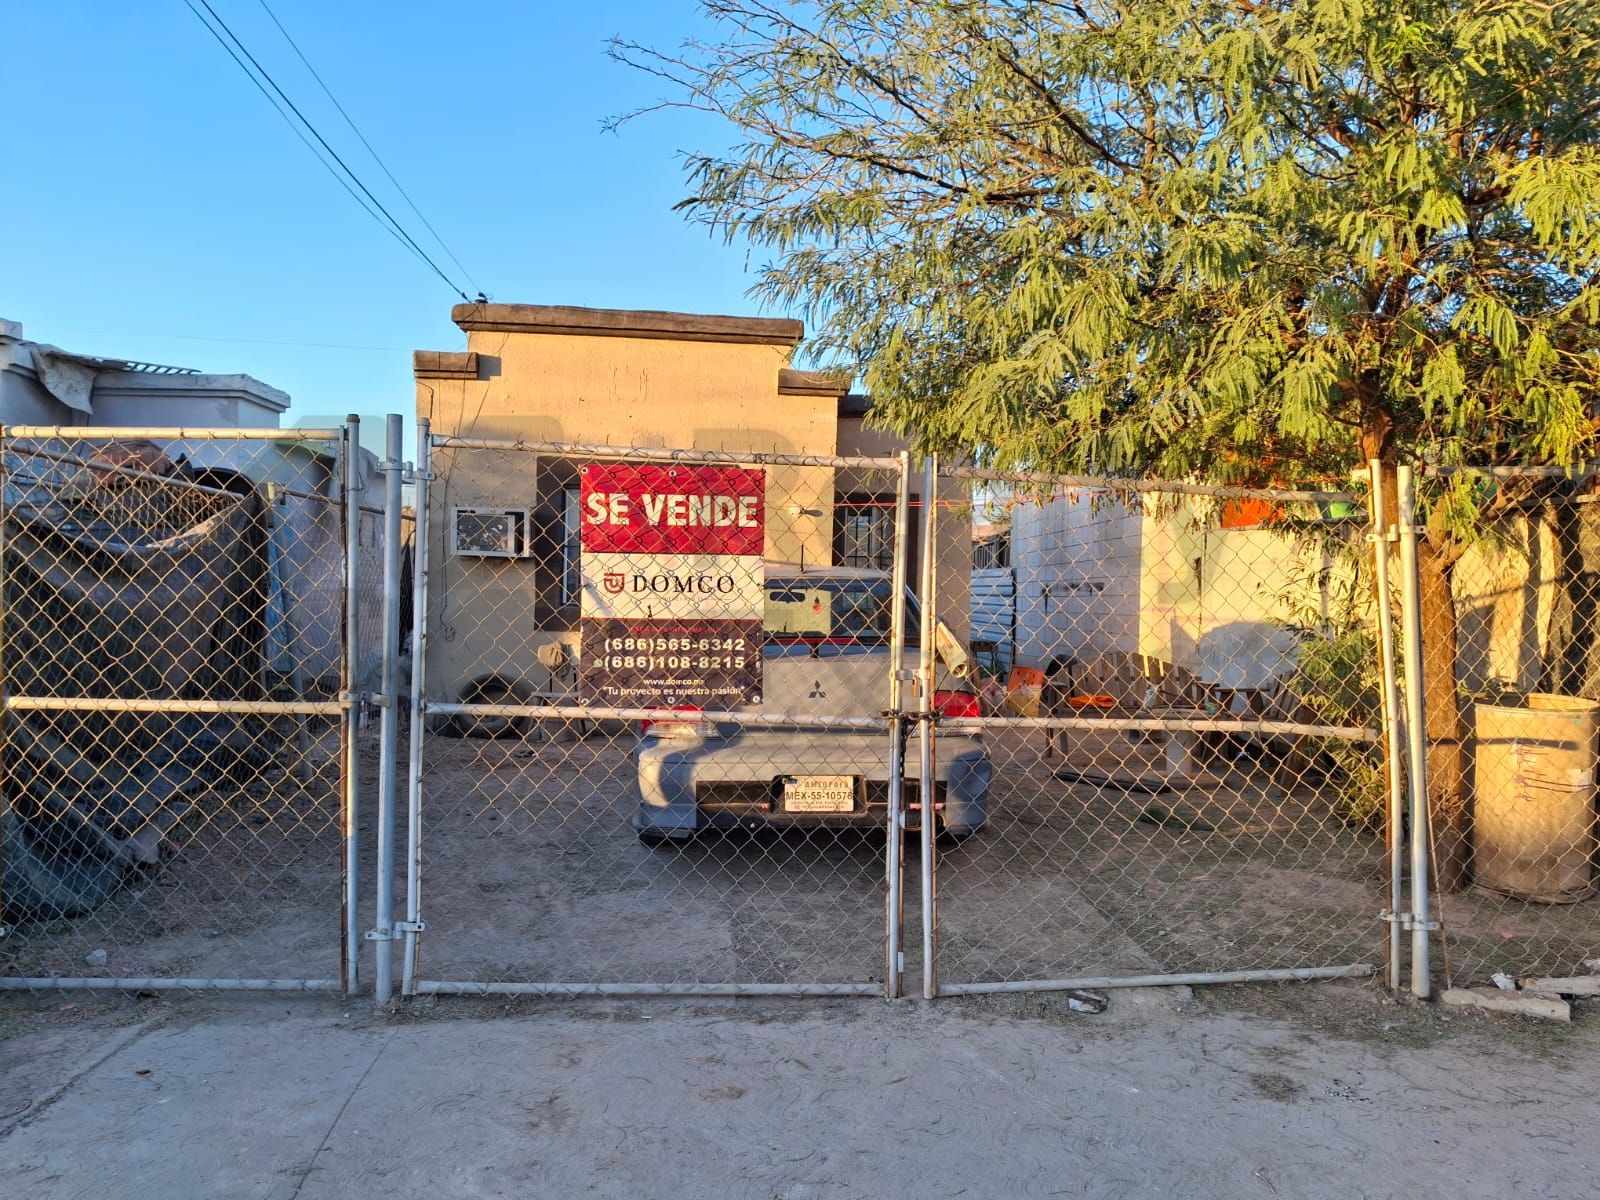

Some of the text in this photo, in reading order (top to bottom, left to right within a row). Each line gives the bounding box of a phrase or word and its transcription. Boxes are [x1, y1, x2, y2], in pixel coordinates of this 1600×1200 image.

[587, 493, 758, 528] SE VENDE
[632, 575, 735, 593] DOMCO
[604, 638, 745, 653] (686)565-6342
[604, 656, 745, 671] (686)108-8215
[620, 687, 661, 697] proyecto
[676, 687, 710, 695] nuestra
